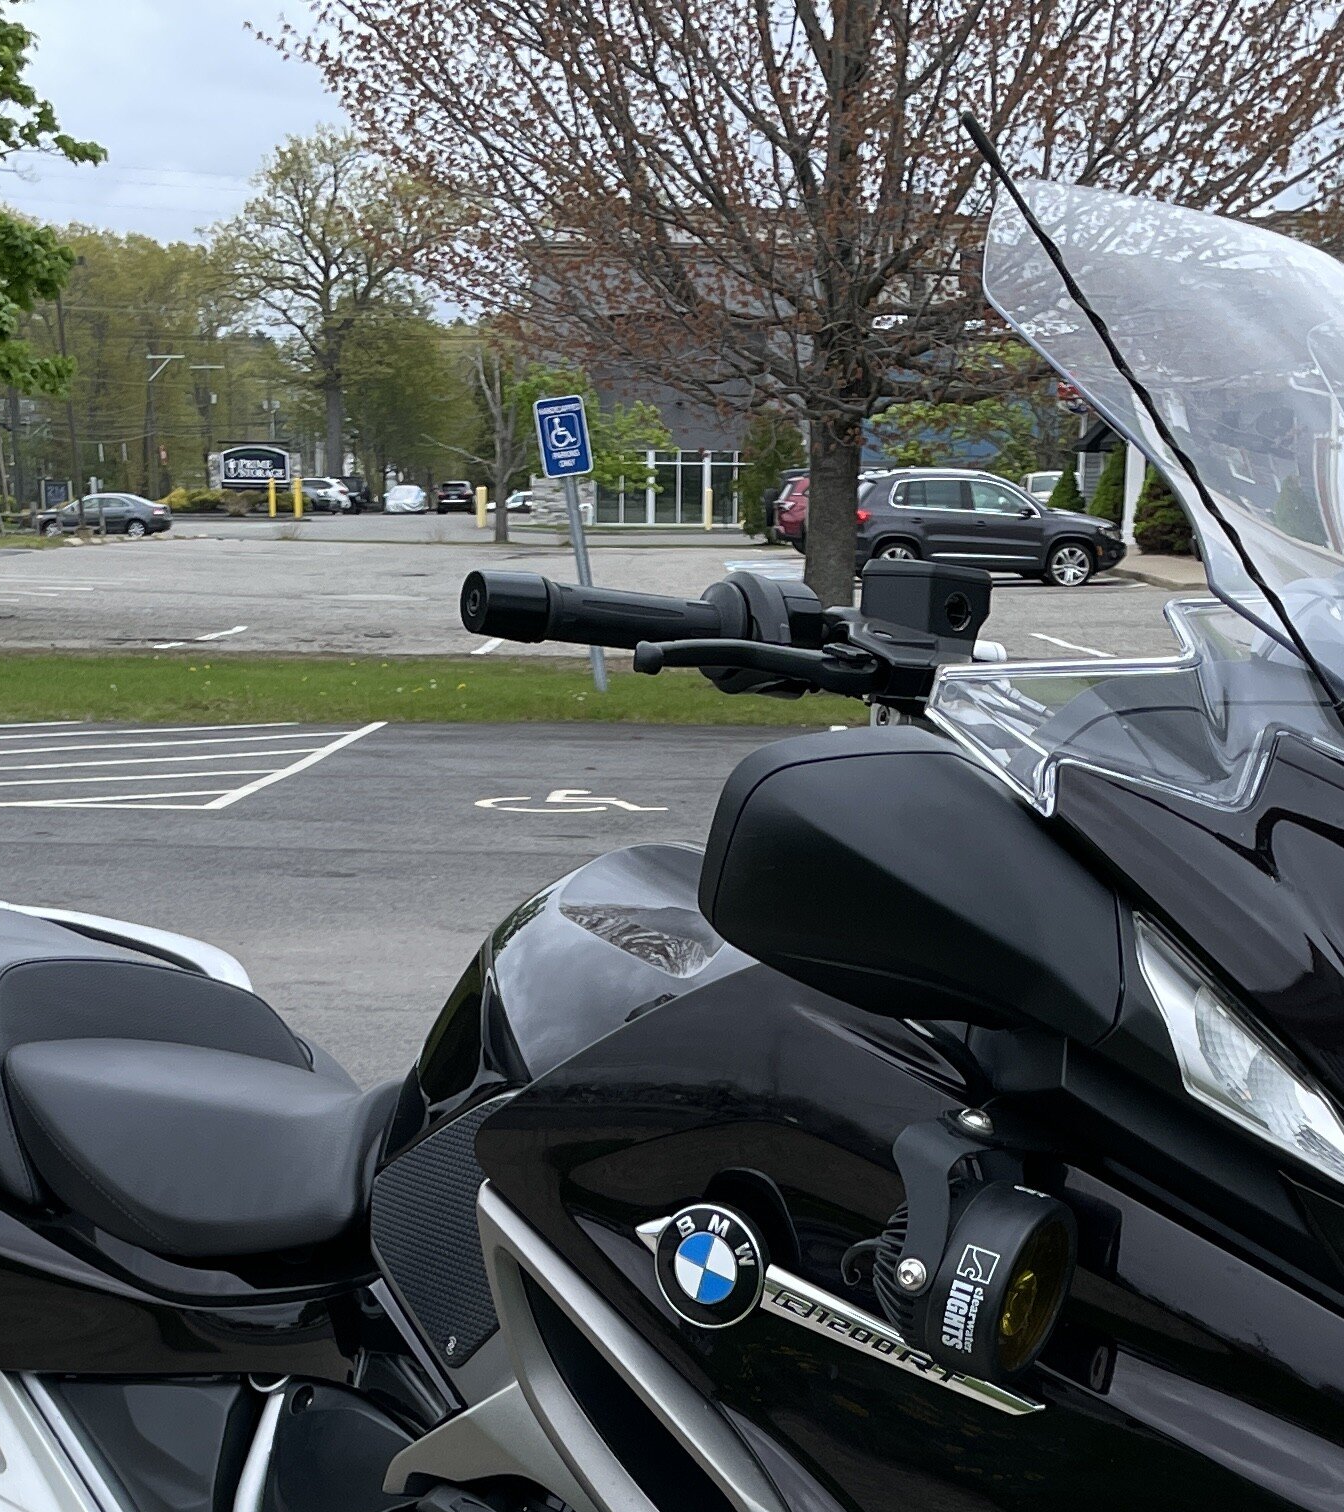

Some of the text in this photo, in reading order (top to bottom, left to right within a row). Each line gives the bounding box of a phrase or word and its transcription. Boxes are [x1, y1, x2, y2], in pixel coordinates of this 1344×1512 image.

[675, 1213, 756, 1268] BMW
[941, 1279, 975, 1351] LIGHTS
[963, 1286, 985, 1354] clearwater
